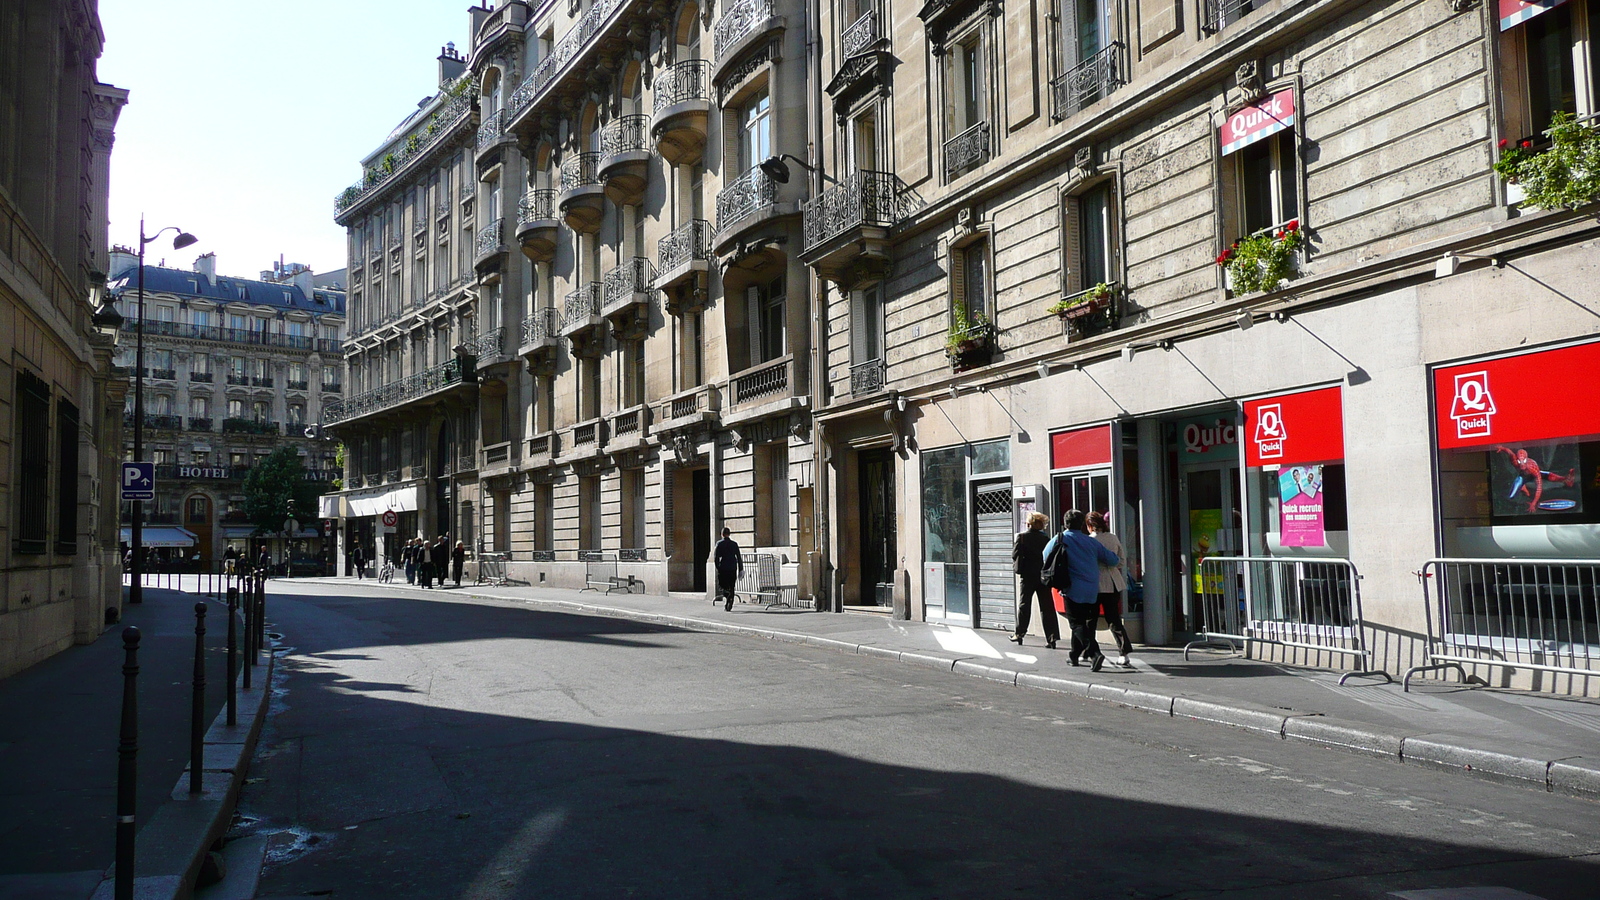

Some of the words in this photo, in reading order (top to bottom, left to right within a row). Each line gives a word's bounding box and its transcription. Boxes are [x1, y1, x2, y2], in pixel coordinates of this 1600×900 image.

[1231, 95, 1283, 139] Quick
[1460, 380, 1486, 411] Q
[1261, 411, 1280, 436] Q
[1460, 417, 1487, 430] Quick
[1261, 441, 1281, 452] Quick
[124, 467, 142, 487] P
[179, 467, 229, 479] HOTEL
[1282, 504, 1298, 514] Quick
[1299, 504, 1322, 513] recrute
